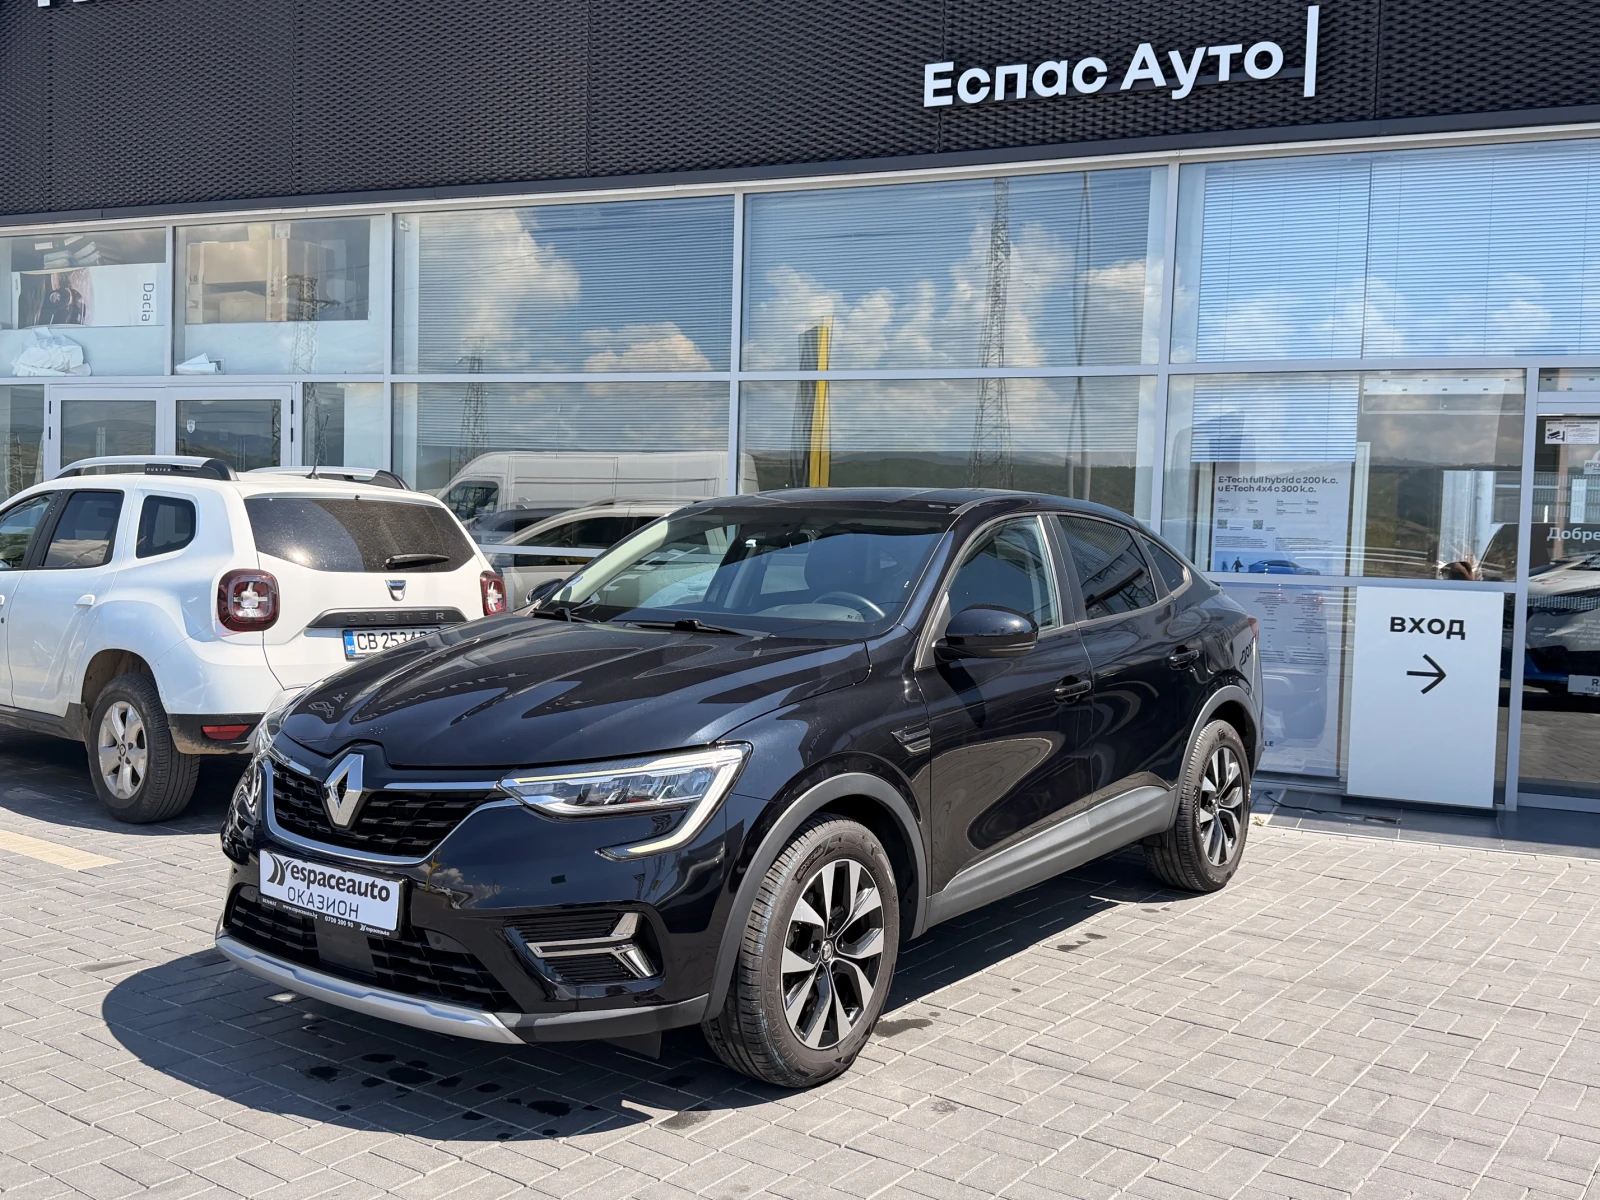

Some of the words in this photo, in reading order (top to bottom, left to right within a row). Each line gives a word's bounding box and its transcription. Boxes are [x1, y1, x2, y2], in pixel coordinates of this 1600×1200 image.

[924, 57, 1108, 107] Еспас
[1120, 41, 1284, 99] Ауто
[141, 282, 155, 322] Dacia
[1218, 476, 1249, 484] E-Tech
[1250, 476, 1264, 484] full
[1265, 476, 1294, 485] hybrid
[1281, 485, 1299, 493] 300
[1546, 527, 1600, 543] Добре
[347, 612, 445, 622] DUSTER
[291, 864, 390, 902] espaceauto
[287, 886, 359, 919] ОКАЗИОН
